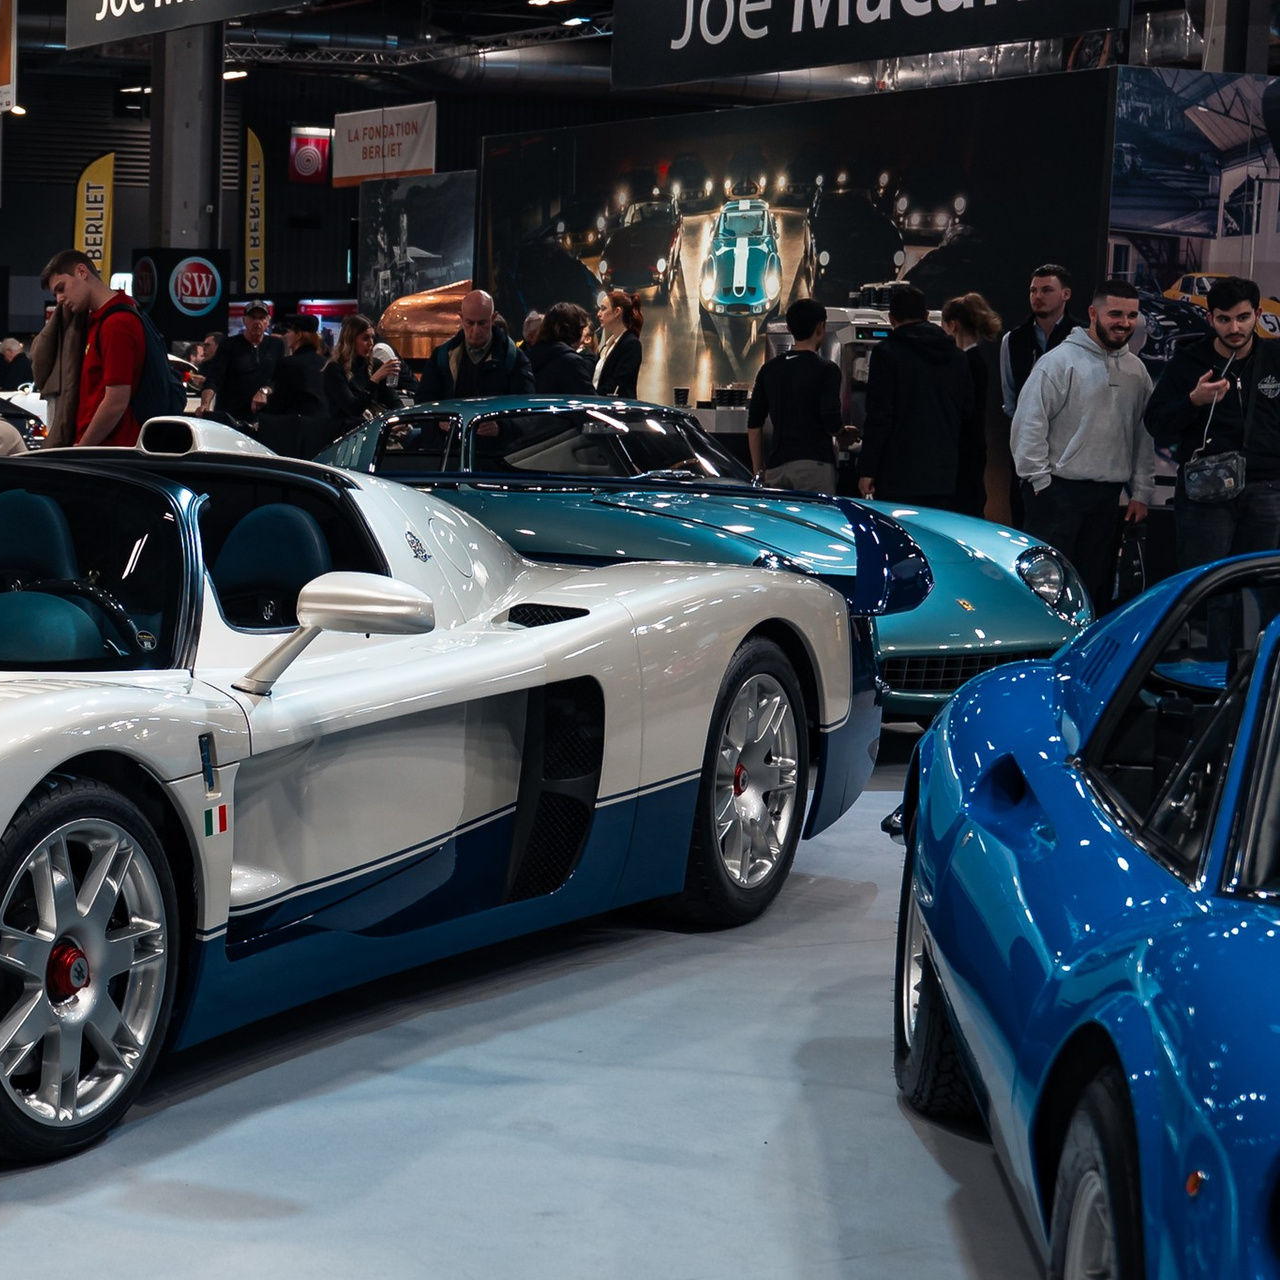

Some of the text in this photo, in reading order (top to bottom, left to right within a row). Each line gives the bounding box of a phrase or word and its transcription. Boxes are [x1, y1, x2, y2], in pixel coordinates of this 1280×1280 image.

[347, 121, 418, 142] LA FONDATION
[361, 143, 402, 160] BERLIET
[84, 183, 105, 260] BERLIET
[177, 272, 213, 300] JSW
